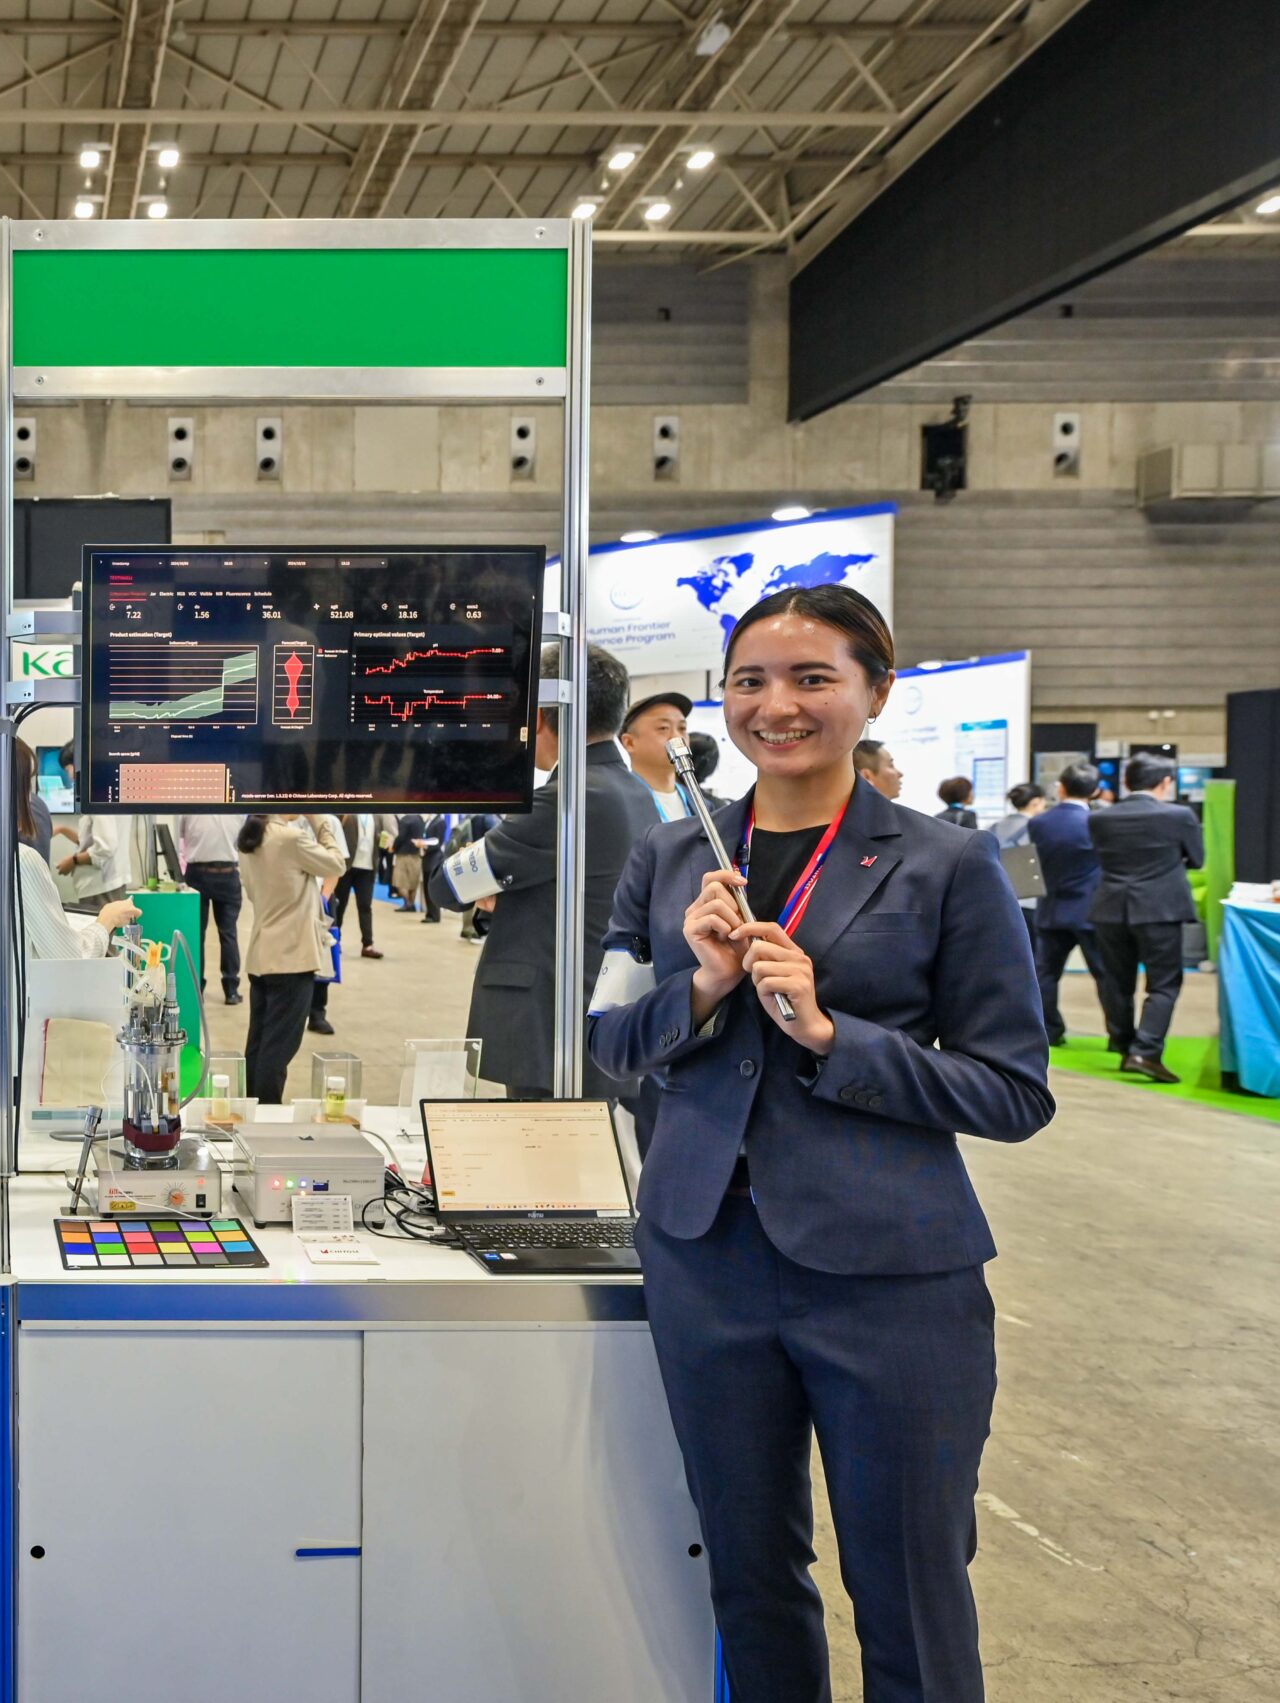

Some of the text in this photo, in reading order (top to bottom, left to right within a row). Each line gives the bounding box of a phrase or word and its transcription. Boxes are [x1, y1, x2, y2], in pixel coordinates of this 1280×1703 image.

[126, 611, 481, 619] 7.22 1.56 36.01 521.08 18.16 0.63
